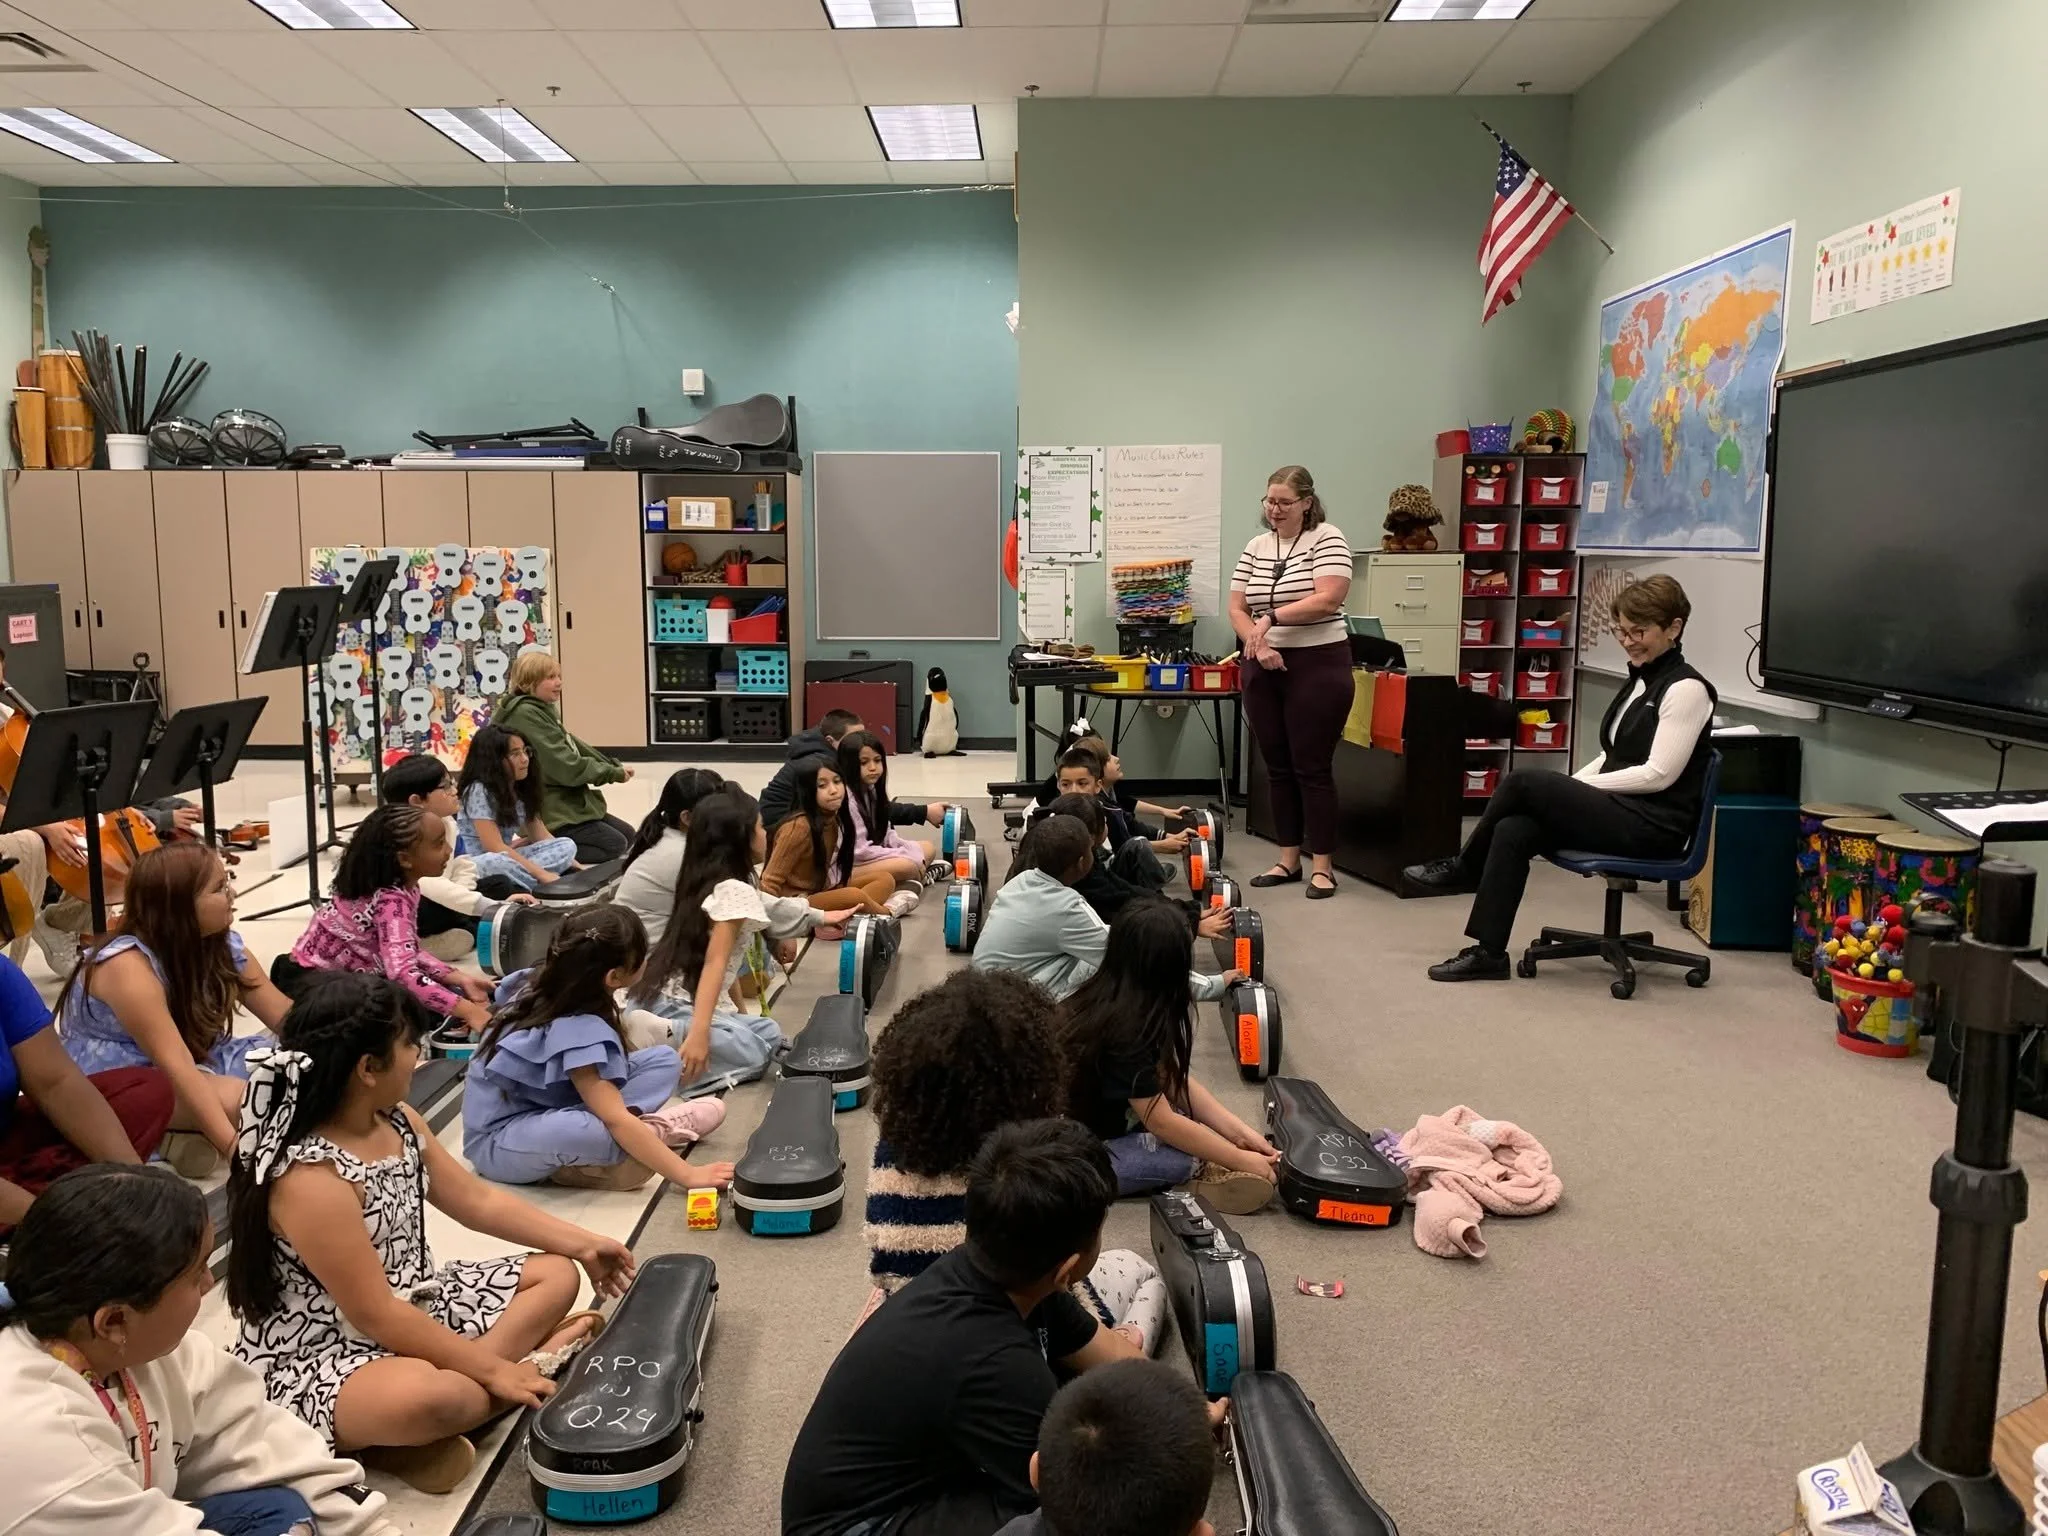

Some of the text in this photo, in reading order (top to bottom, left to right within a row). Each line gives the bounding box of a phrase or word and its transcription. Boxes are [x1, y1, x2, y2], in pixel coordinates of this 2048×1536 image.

[1116, 448, 1149, 462] Music
[1177, 446, 1204, 460] Rules
[968, 912, 976, 933] RPAK
[1811, 1468, 1851, 1511] CRYSTAL
[582, 1495, 645, 1517] Hellen
